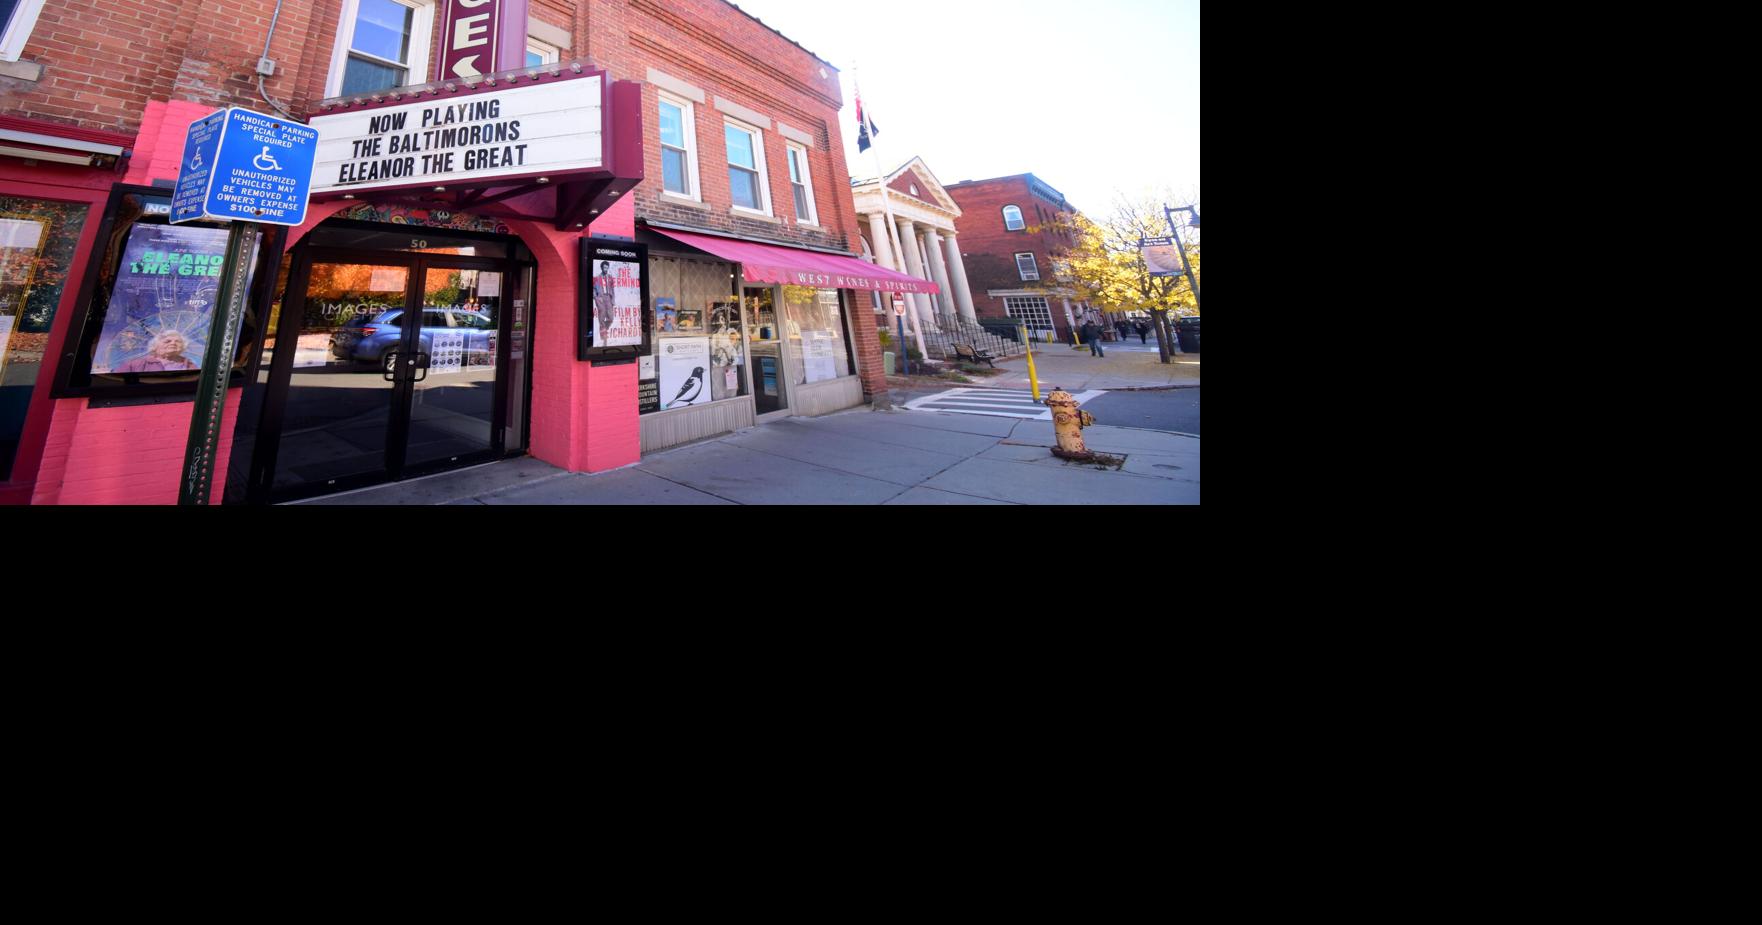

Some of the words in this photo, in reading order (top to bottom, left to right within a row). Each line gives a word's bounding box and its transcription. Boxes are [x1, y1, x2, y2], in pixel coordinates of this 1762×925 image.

[369, 112, 407, 134] NOW
[422, 99, 500, 127] PLAYING
[241, 123, 276, 138] SPECIAL
[282, 133, 306, 145] PLATE
[281, 125, 315, 139] PARKING
[352, 137, 382, 158] THE
[389, 120, 520, 154] BALTIMORONS
[253, 134, 293, 148] REQUIRED
[338, 156, 415, 182] ELEANOR
[421, 152, 454, 174] THE
[464, 144, 527, 171] GREAT
[232, 169, 296, 186] UNAUTHORIZED
[222, 184, 235, 194] BE
[241, 187, 282, 200] REMOVED
[287, 194, 297, 202] AT
[230, 177, 272, 190] VEHICLES
[278, 185, 295, 194] MAY
[145, 204, 170, 214] NO
[216, 193, 255, 205] OWNER'S
[261, 199, 299, 211] EXPENSE
[411, 239, 427, 248] 50
[142, 251, 224, 266] ELEANO
[596, 248, 619, 256] COMING
[129, 262, 170, 275] THE
[178, 265, 221, 277] GRE
[618, 267, 631, 278] THE
[798, 272, 830, 285] WEST
[837, 276, 869, 288] WINES
[874, 281, 881, 289] &
[885, 281, 918, 291] SPIRITS
[321, 303, 388, 315] IMAGES
[436, 303, 487, 315] IMAGES
[614, 306, 631, 318] FILM
